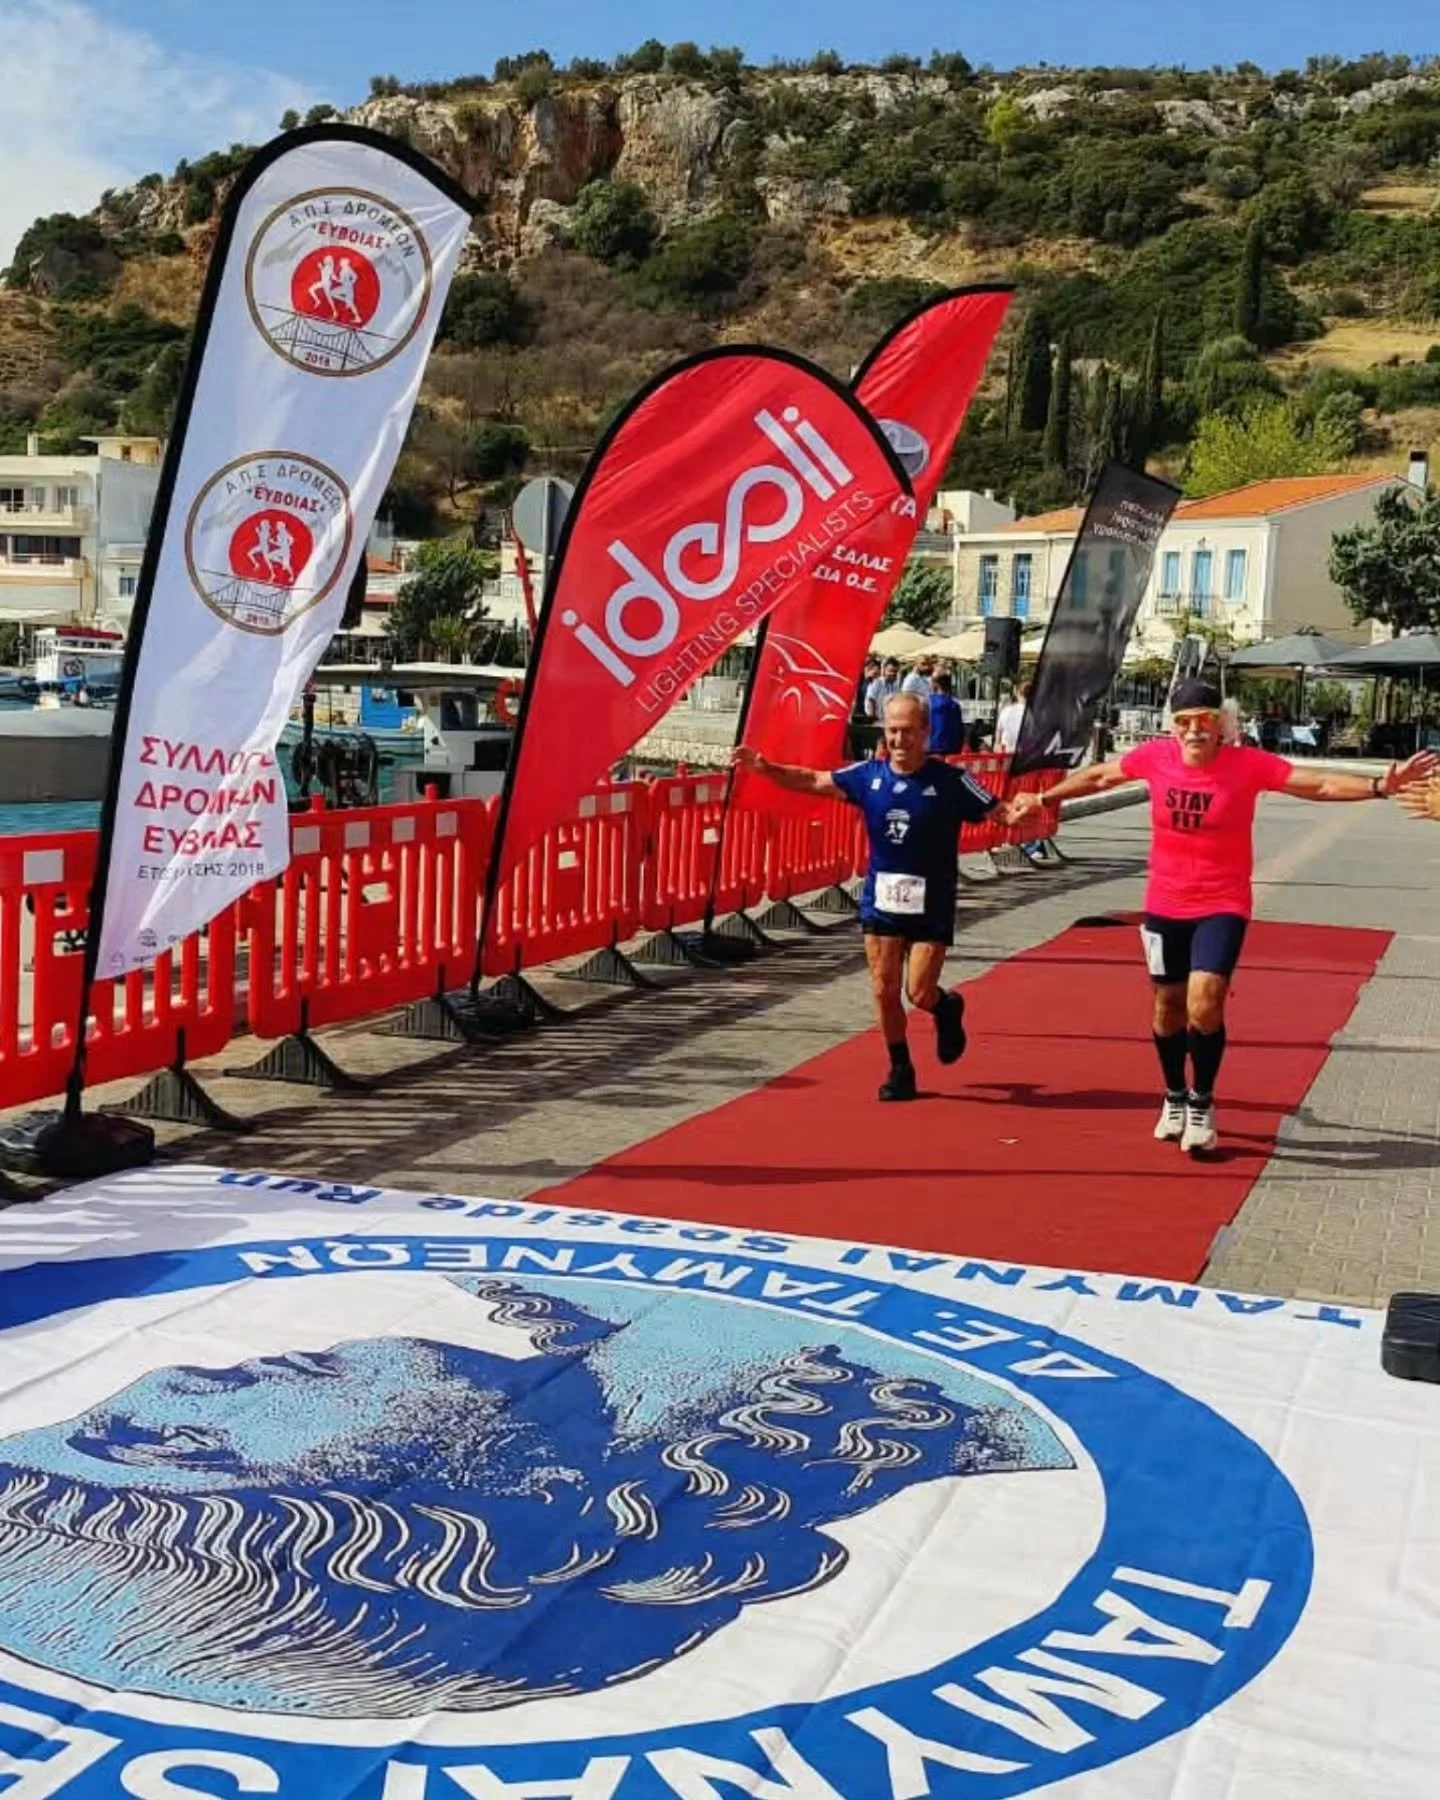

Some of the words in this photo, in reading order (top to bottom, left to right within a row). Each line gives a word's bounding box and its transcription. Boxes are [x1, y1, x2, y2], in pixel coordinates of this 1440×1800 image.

[636, 611, 739, 714] LIGHTING
[735, 490, 875, 616] SPECIALISTS
[1165, 788, 1215, 813] STAY
[1171, 811, 1205, 830] FIT
[228, 862, 266, 877] 2018
[218, 1171, 383, 1205] Run
[237, 1240, 880, 1319] ΤΑΜΥΝΕΩΝ
[838, 1247, 1362, 1330] TAMYNAI
